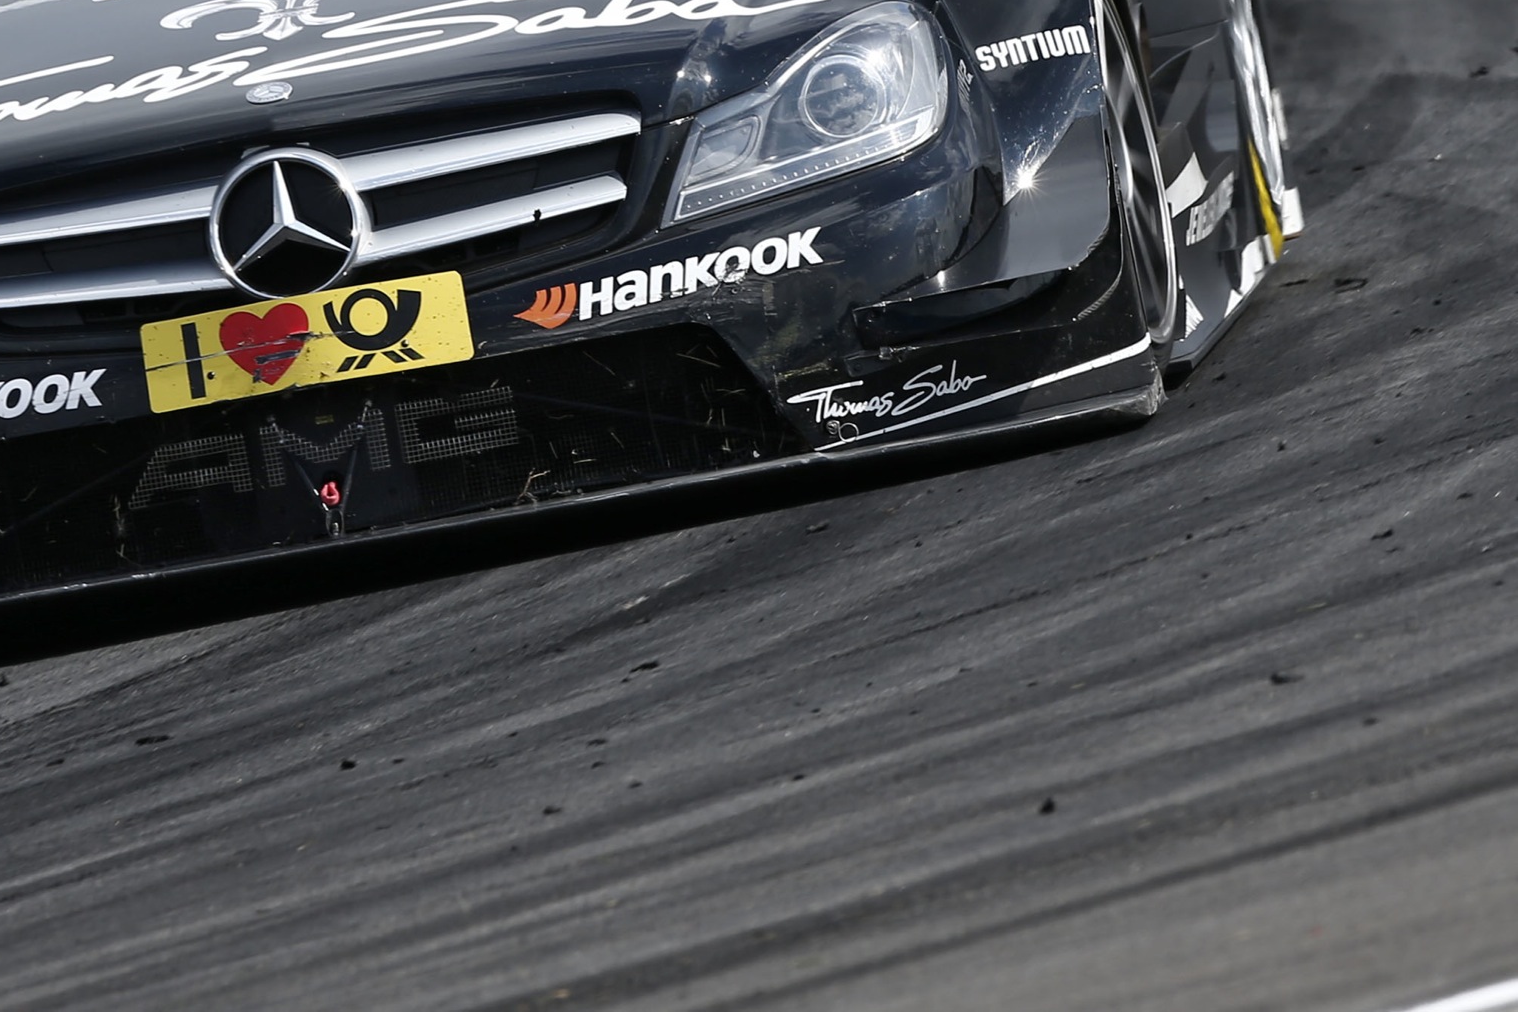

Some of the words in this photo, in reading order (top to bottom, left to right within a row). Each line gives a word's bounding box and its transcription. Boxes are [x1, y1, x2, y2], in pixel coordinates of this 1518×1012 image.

[975, 25, 1091, 72] SYNTIUM
[180, 322, 207, 401] I
[786, 380, 894, 423] Thomas
[891, 359, 987, 416] Sabo
[128, 386, 520, 510] AMG
